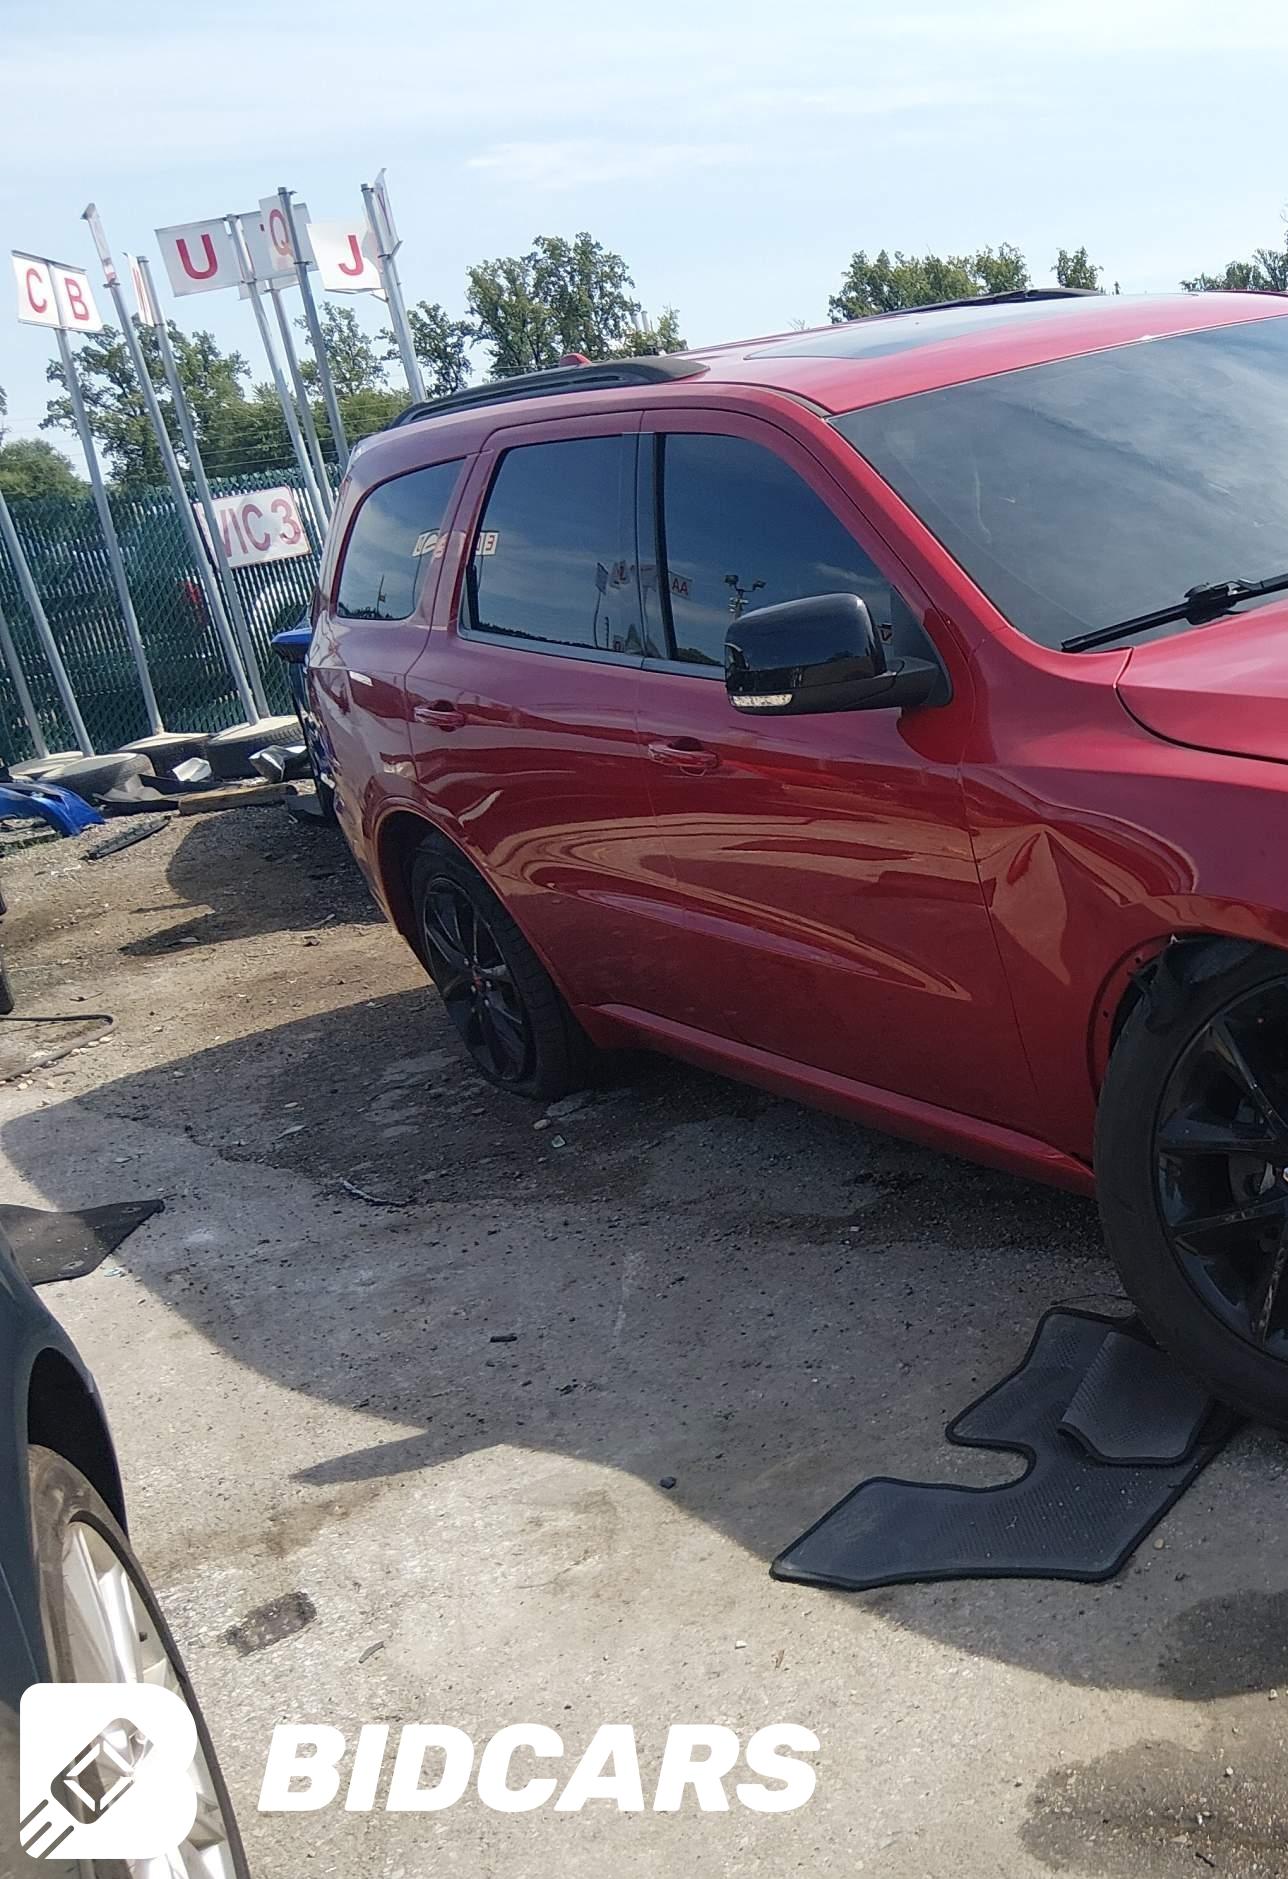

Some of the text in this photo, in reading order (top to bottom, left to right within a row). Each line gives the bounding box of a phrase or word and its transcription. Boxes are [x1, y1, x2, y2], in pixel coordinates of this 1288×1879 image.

[175, 233, 219, 280] U
[337, 234, 364, 276] J
[26, 267, 47, 314] C
[64, 277, 90, 321] B
[270, 498, 301, 545] 3
